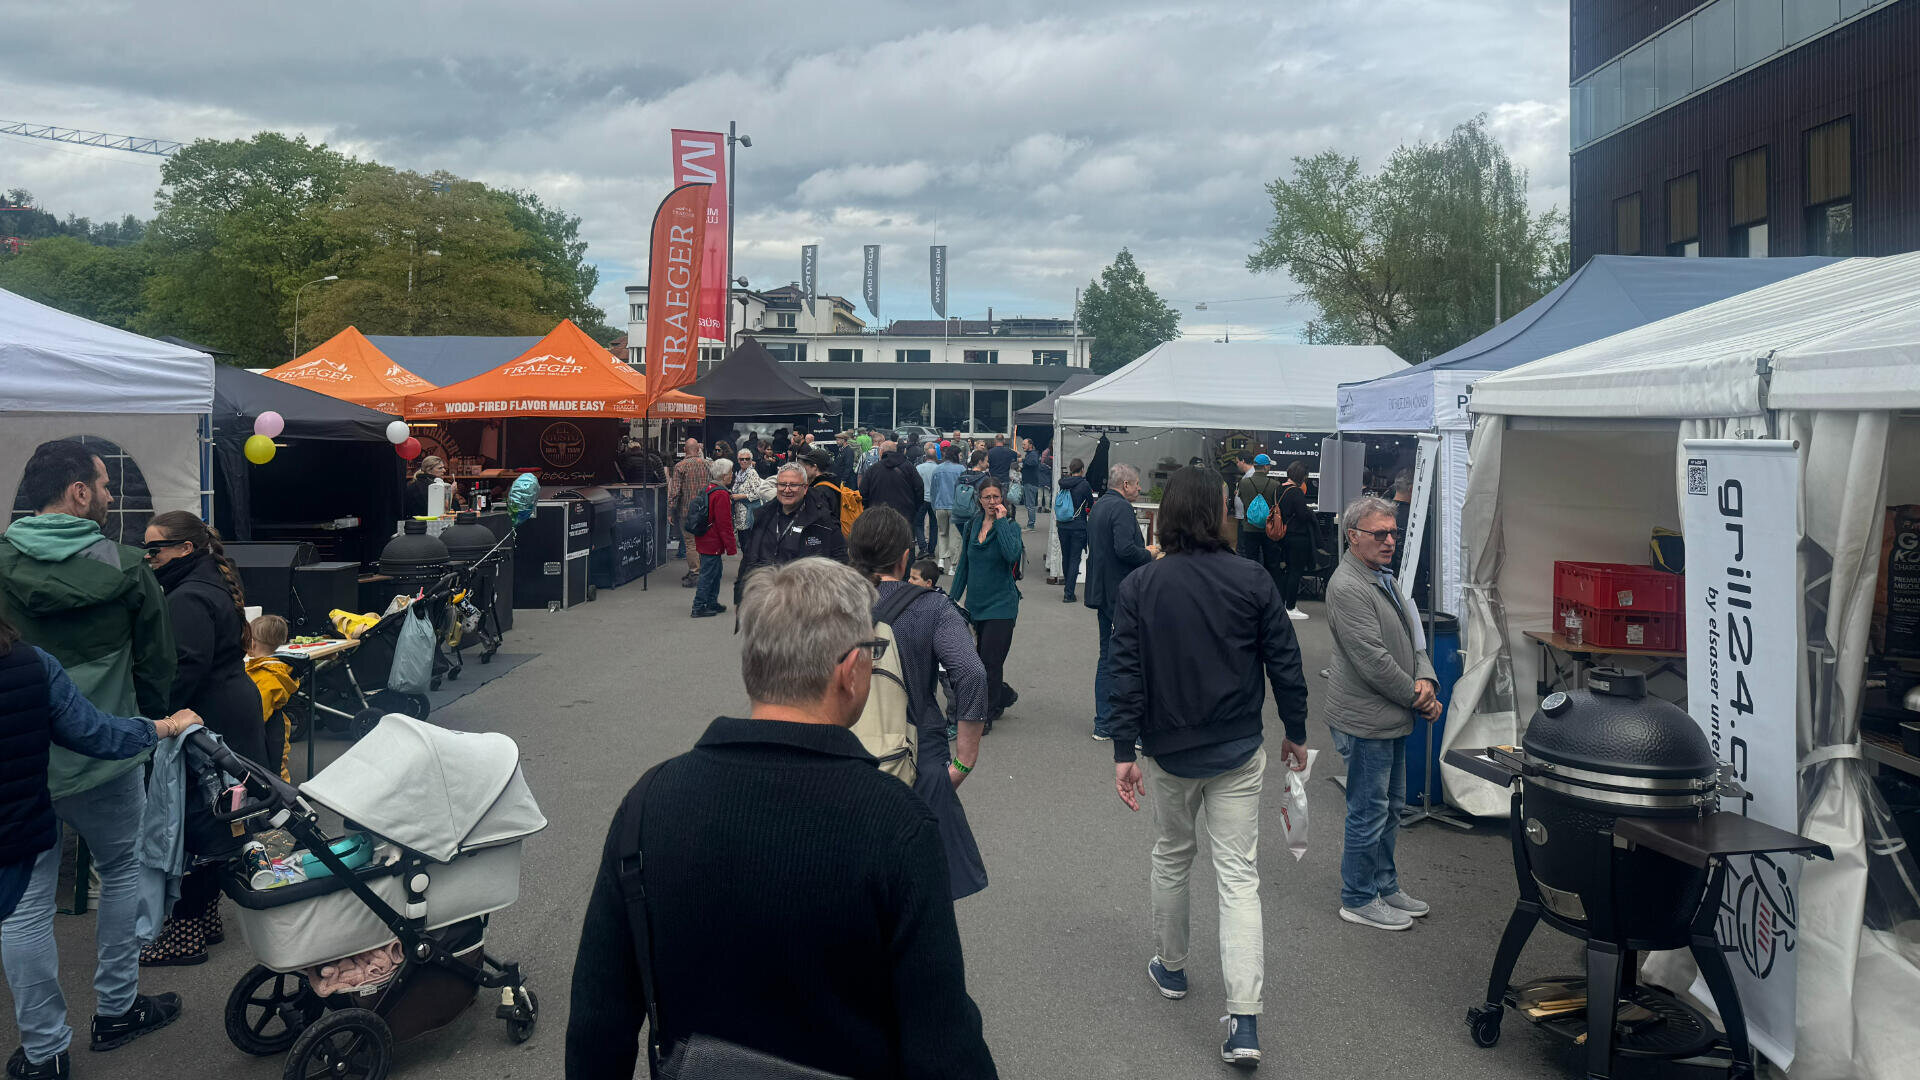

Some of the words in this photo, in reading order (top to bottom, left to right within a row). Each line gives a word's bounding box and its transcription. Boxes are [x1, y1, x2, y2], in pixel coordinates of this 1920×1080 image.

[662, 225, 694, 375] TRAEGER
[275, 367, 354, 382] TRAEGER
[503, 364, 583, 374] TRAEGER
[445, 400, 507, 413] WOOD-FIRED
[509, 400, 547, 411] FLAVOR
[549, 400, 578, 411] MADE
[580, 400, 605, 411] EASY
[1707, 586, 1719, 612] by
[1708, 616, 1721, 701] elsasser
